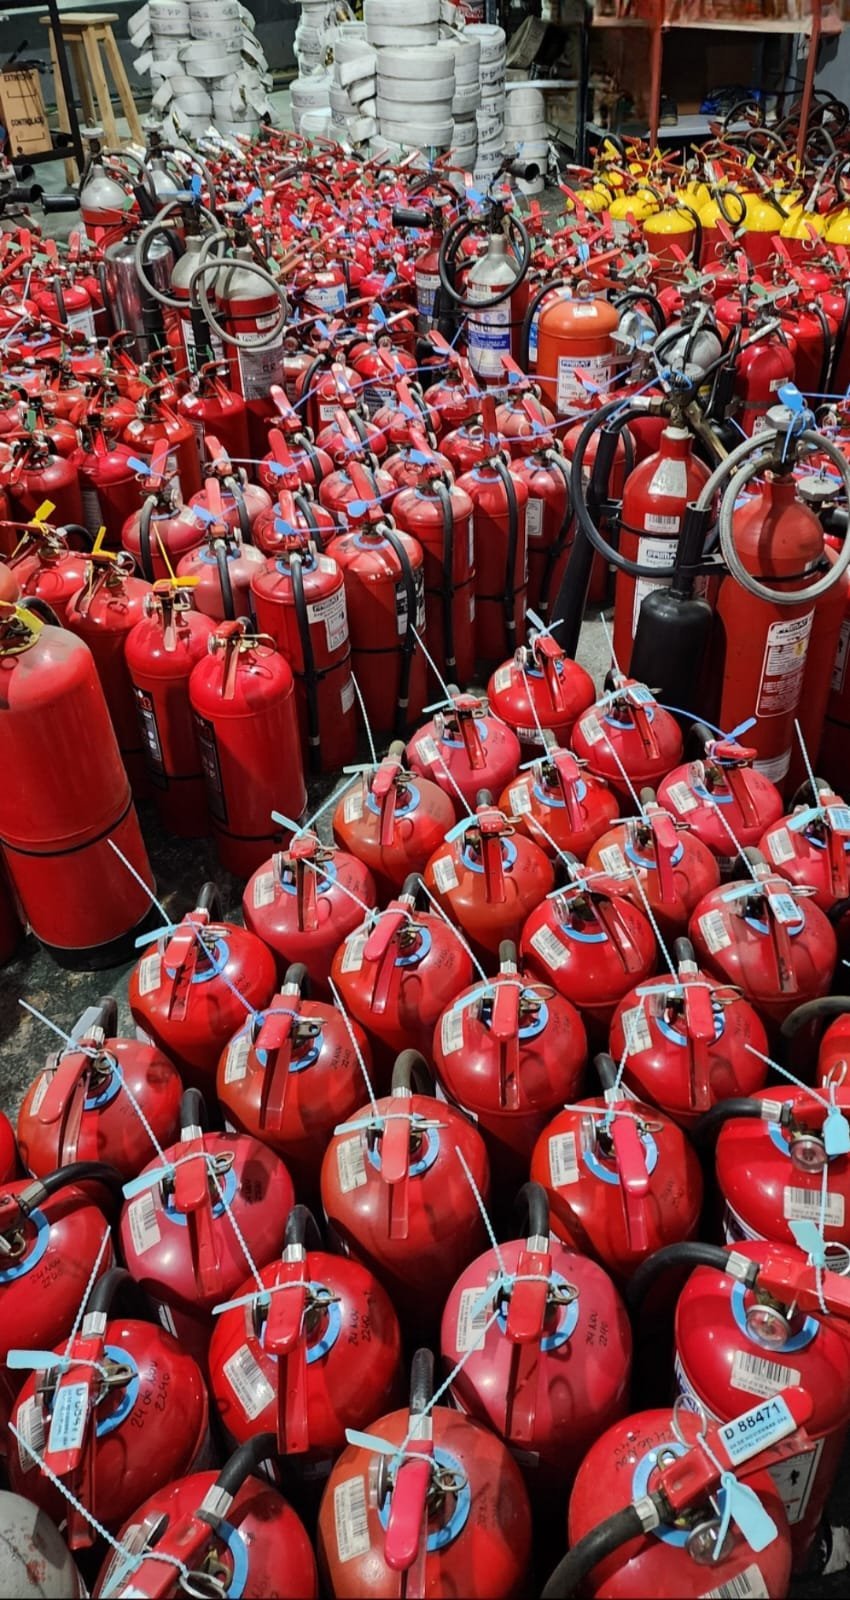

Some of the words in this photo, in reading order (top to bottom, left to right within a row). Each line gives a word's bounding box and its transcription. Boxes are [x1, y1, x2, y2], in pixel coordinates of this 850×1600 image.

[131, 1409, 148, 1428] 24
[724, 1427, 735, 1440] D
[738, 1402, 781, 1432] 88471
